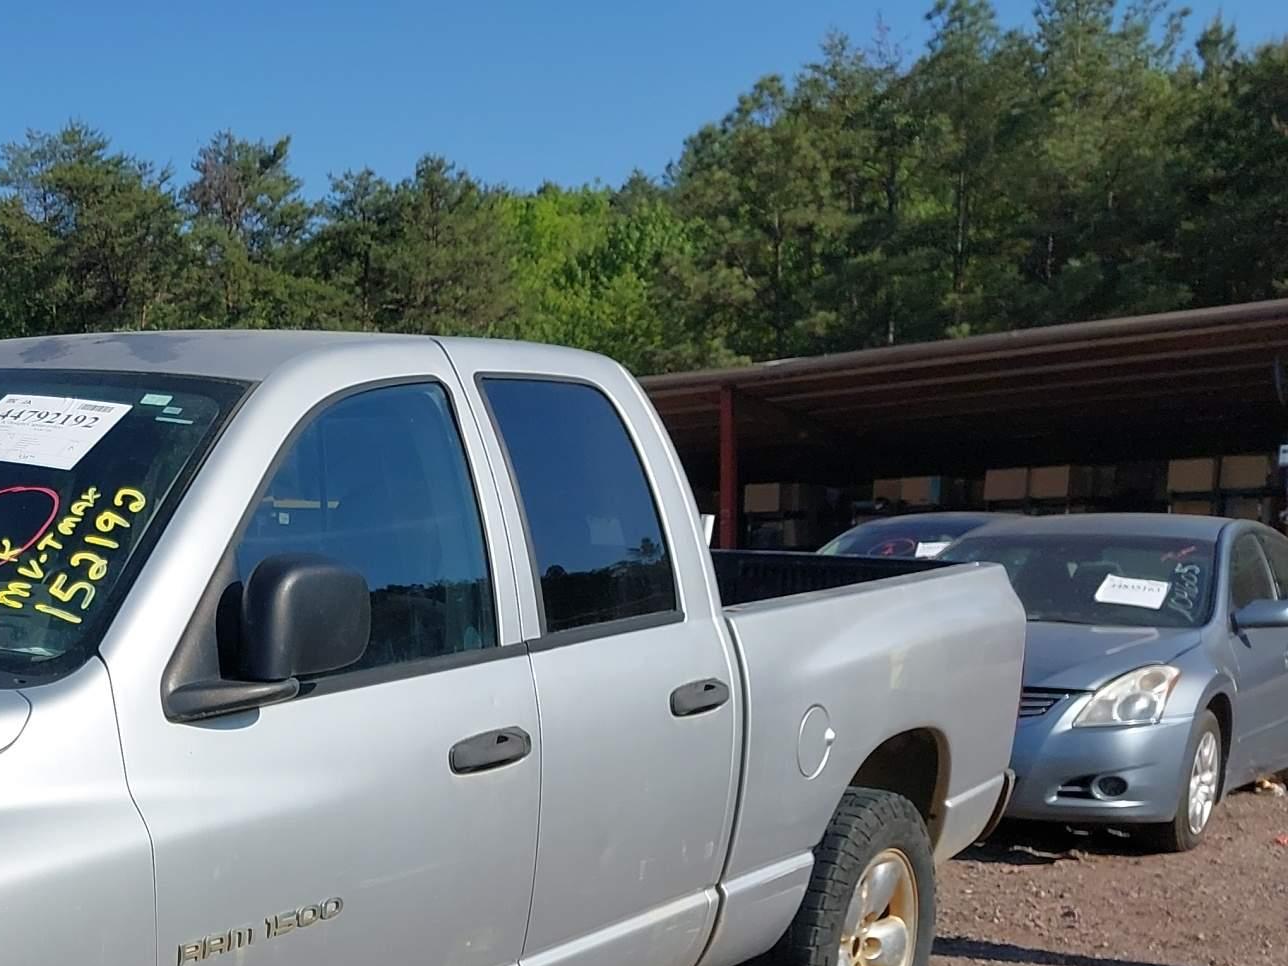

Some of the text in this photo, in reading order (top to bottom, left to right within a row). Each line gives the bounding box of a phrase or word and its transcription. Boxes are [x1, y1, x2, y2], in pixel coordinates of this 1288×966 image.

[35, 488, 146, 624] 152192
[177, 897, 344, 966] RAM 1500
